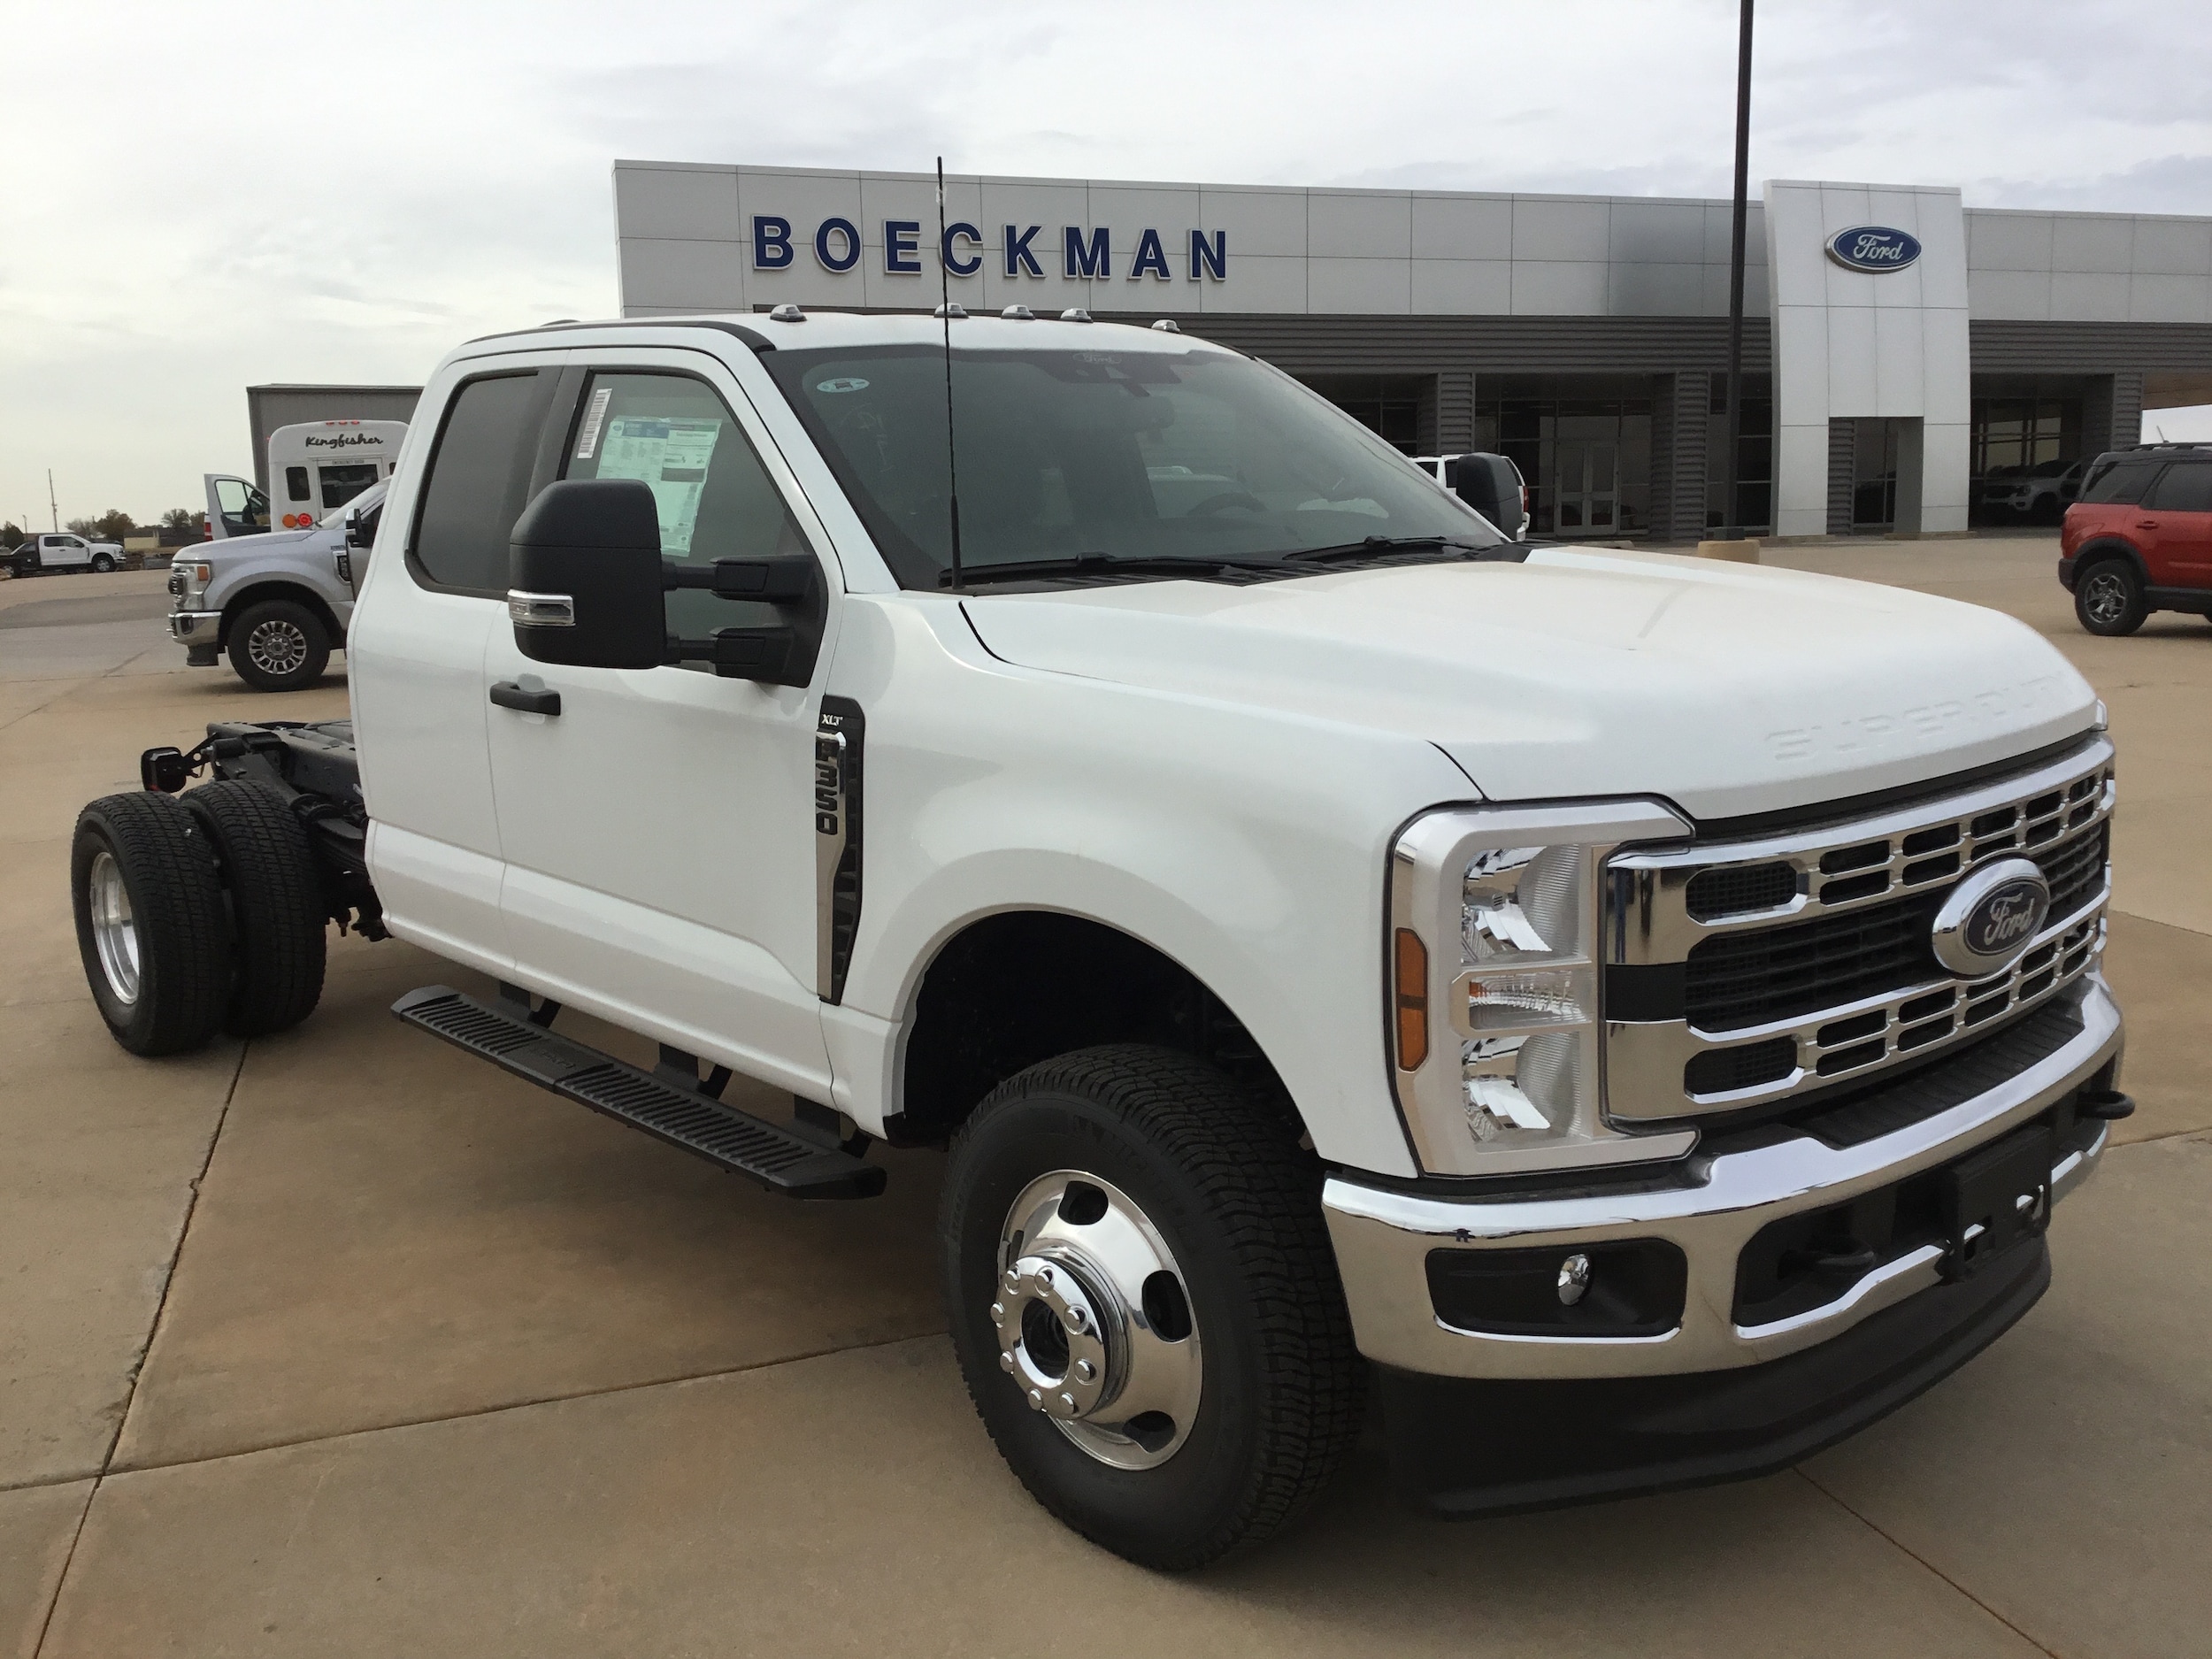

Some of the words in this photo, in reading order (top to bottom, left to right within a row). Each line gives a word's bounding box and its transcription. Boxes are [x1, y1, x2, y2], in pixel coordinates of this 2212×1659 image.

[751, 214, 1228, 281] BOECKMAN
[1853, 234, 1904, 260] Ford
[305, 433, 384, 449] Kingfisher
[821, 713, 843, 726] XLT
[1984, 892, 2035, 946] Ford
